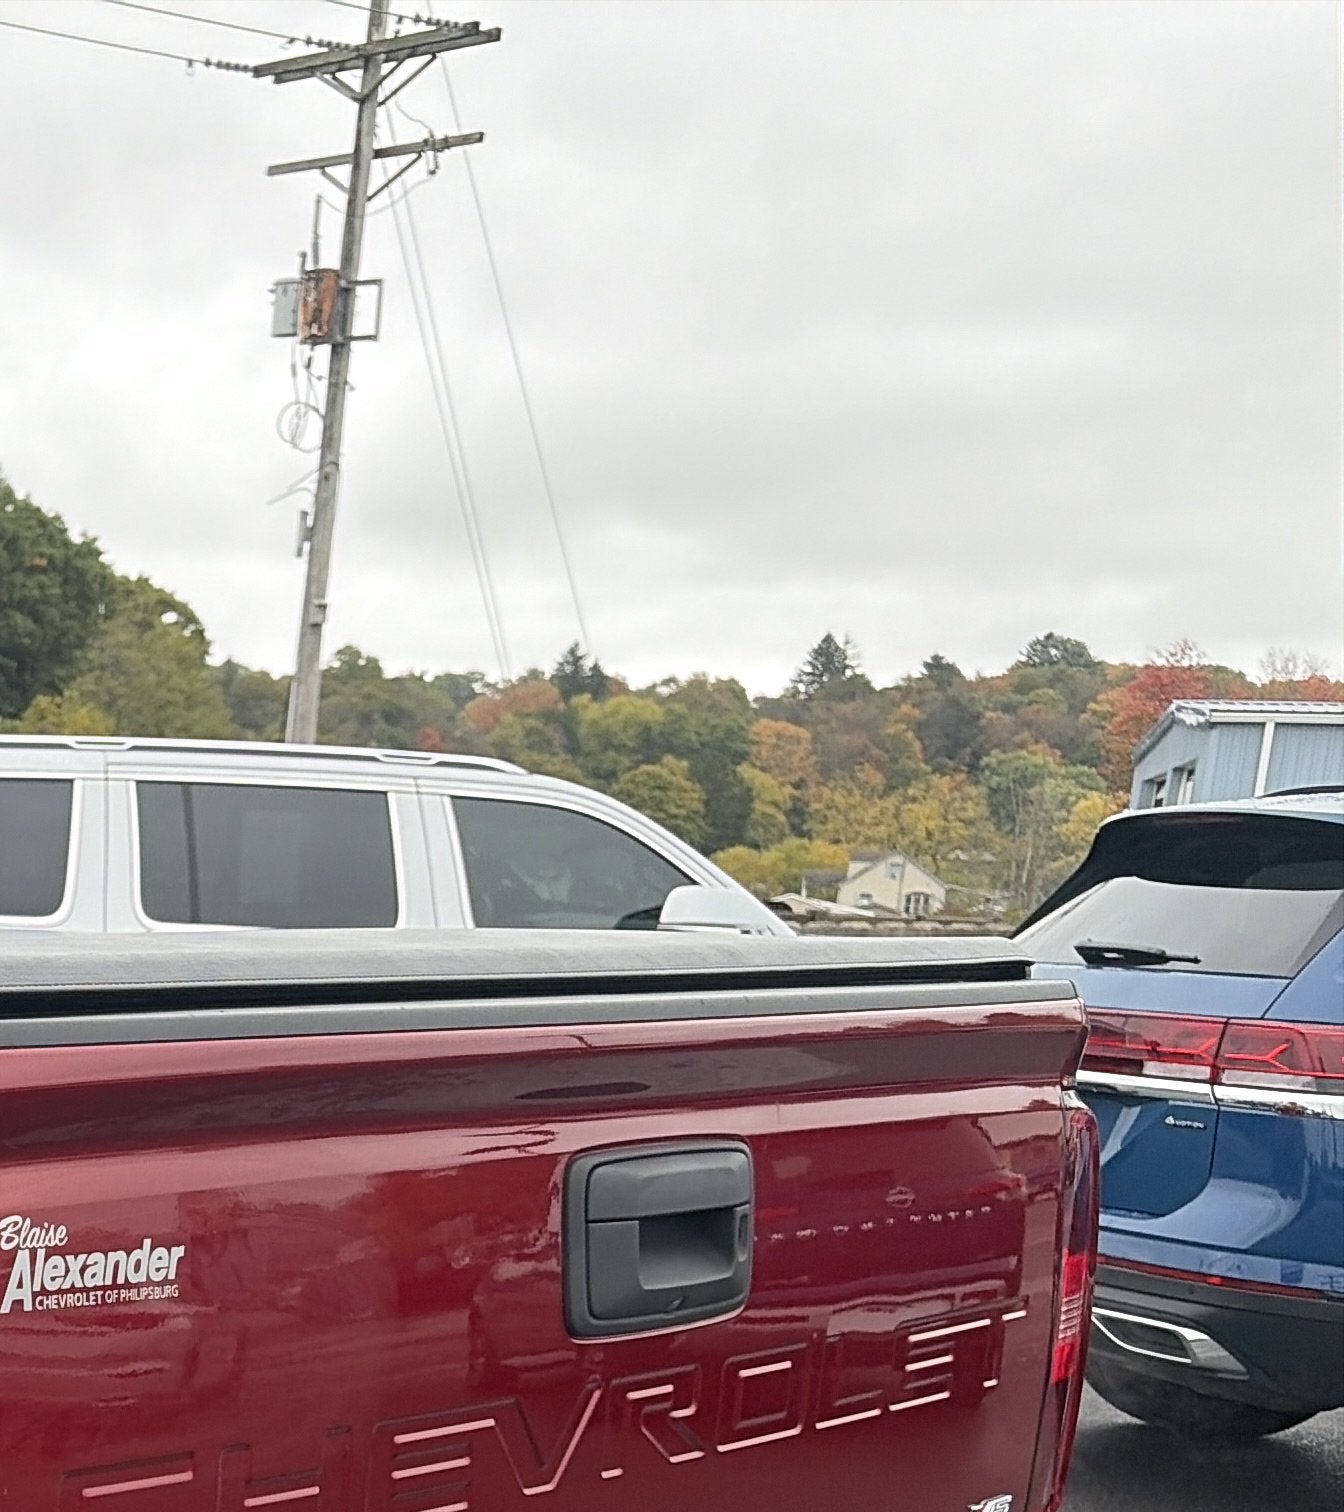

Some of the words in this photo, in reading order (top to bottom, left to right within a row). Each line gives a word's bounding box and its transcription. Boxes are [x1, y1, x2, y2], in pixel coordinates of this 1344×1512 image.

[0, 1238, 185, 1314] Alexander
[35, 1291, 103, 1311] CHEVROLET
[107, 1289, 119, 1305] OF
[120, 1284, 179, 1303] PHILIPSBURG
